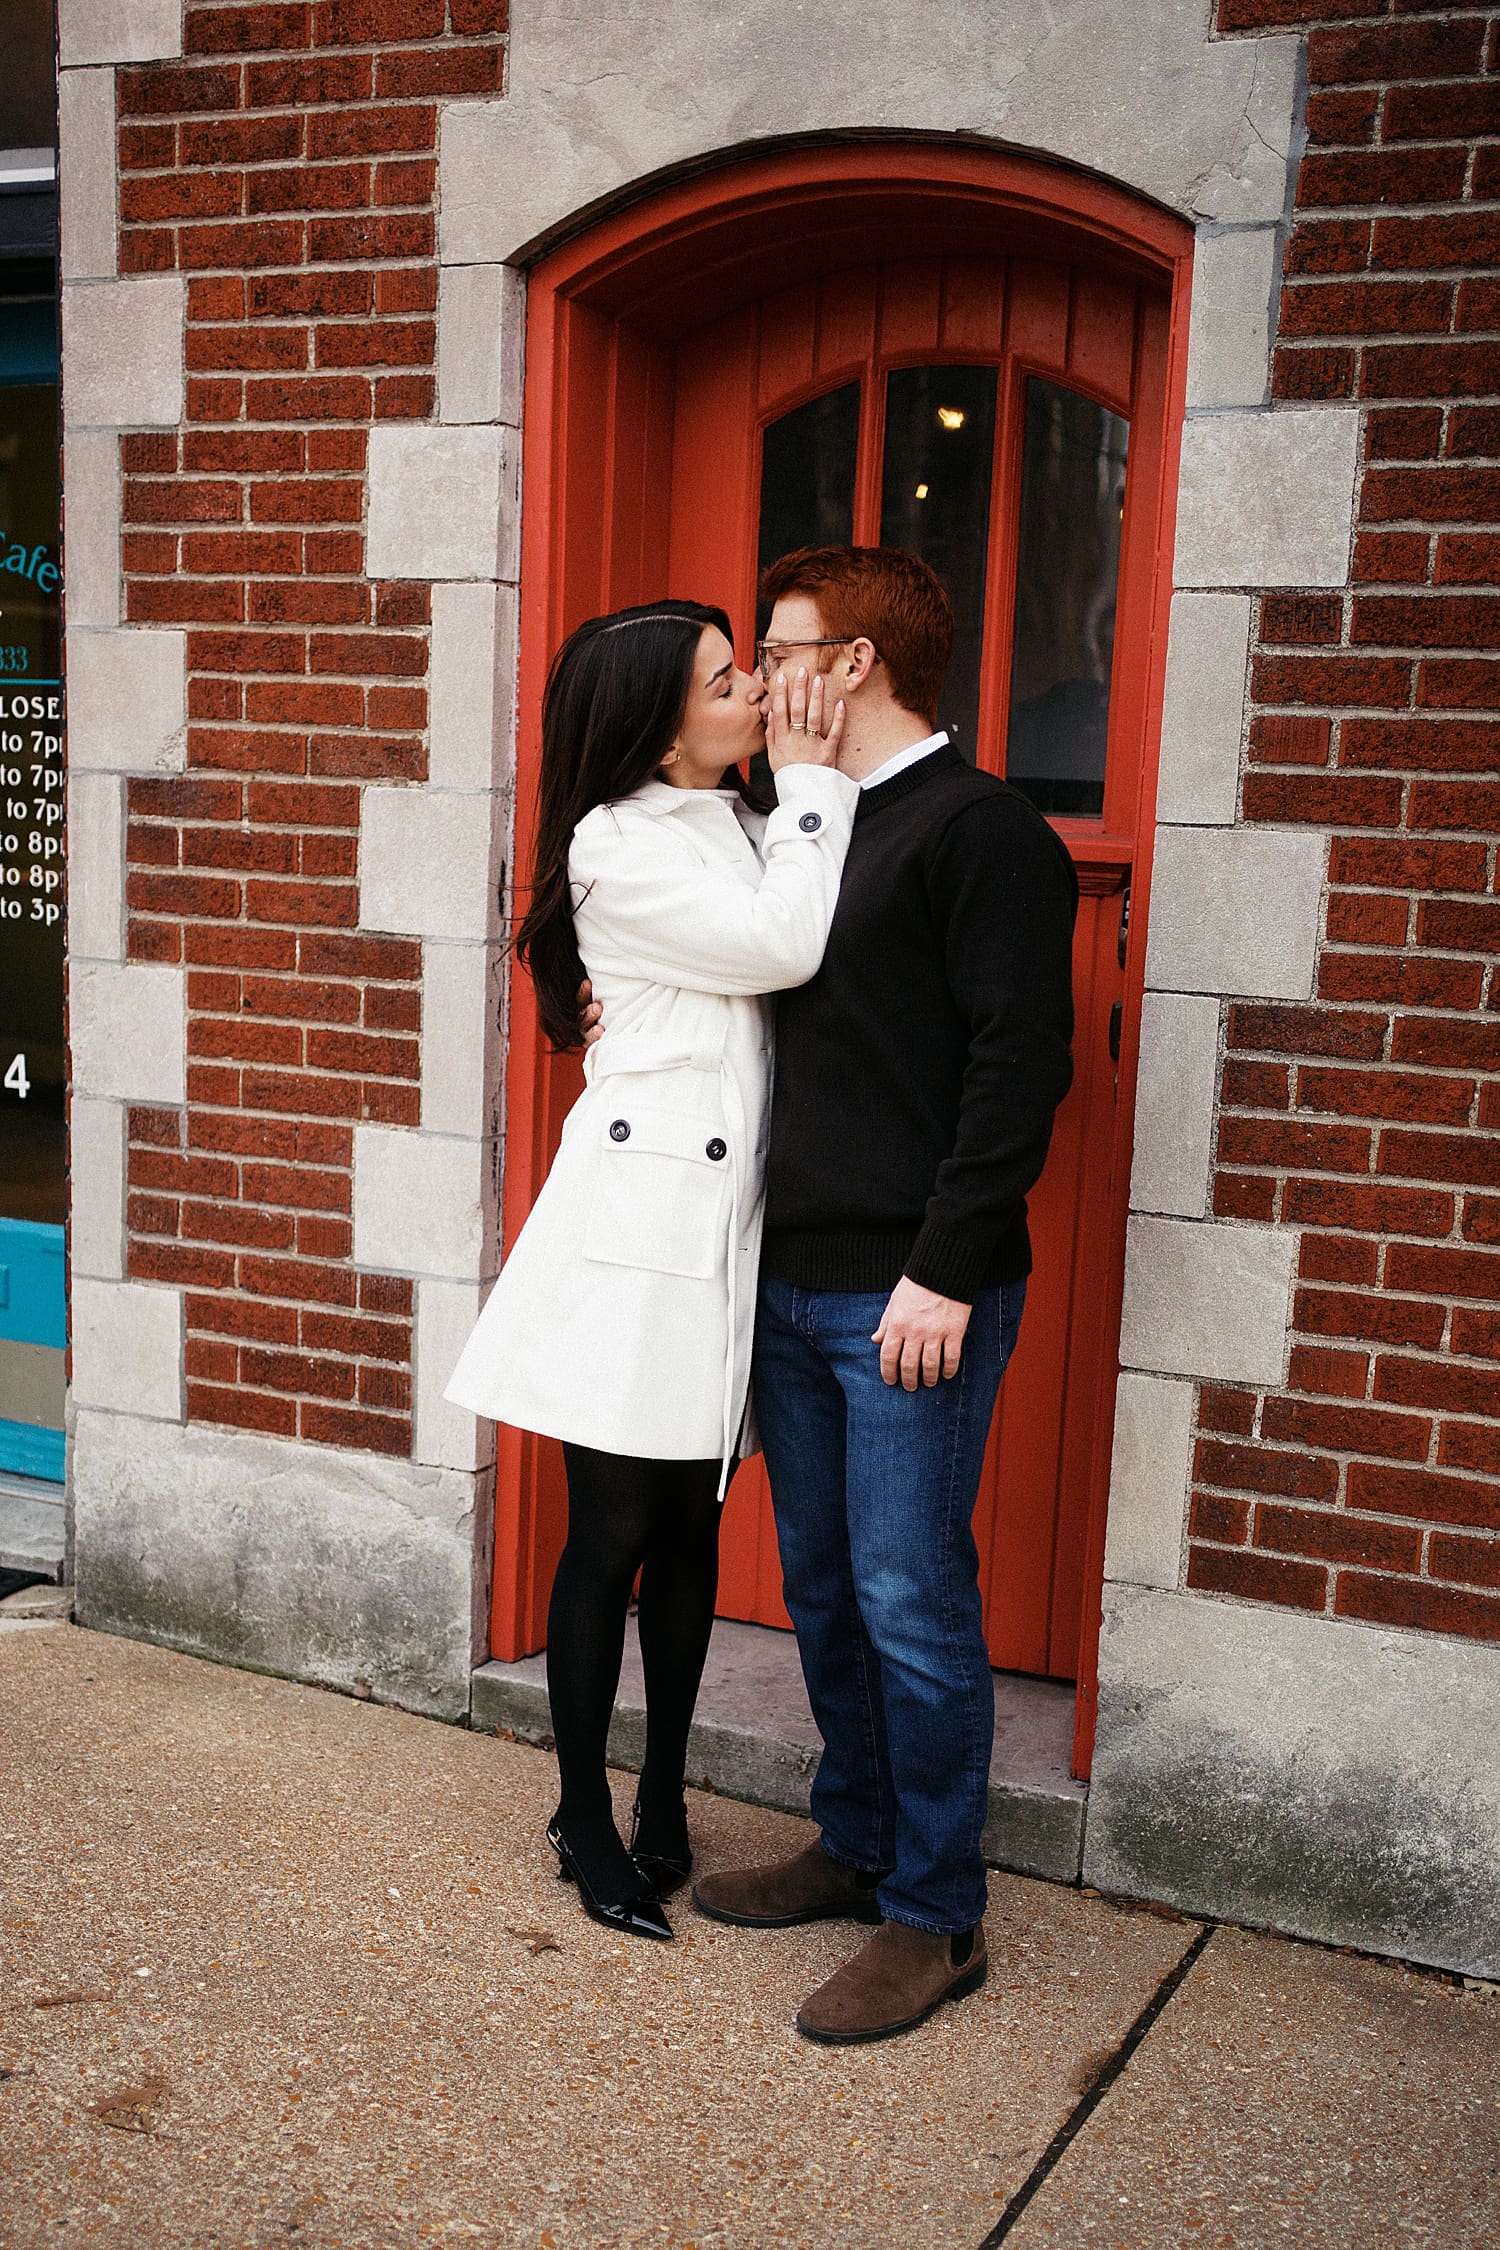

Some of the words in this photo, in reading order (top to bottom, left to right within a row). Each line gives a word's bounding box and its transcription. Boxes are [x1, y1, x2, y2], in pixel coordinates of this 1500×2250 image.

[0, 531, 59, 593] afe
[1, 730, 23, 753] to
[30, 730, 63, 759] 7p
[0, 763, 22, 787] to
[30, 764, 63, 793] 7p
[6, 797, 28, 820] to
[33, 798, 63, 827] 7p
[28, 831, 63, 860] 8p
[29, 864, 62, 894] 8p
[0, 896, 22, 918] to
